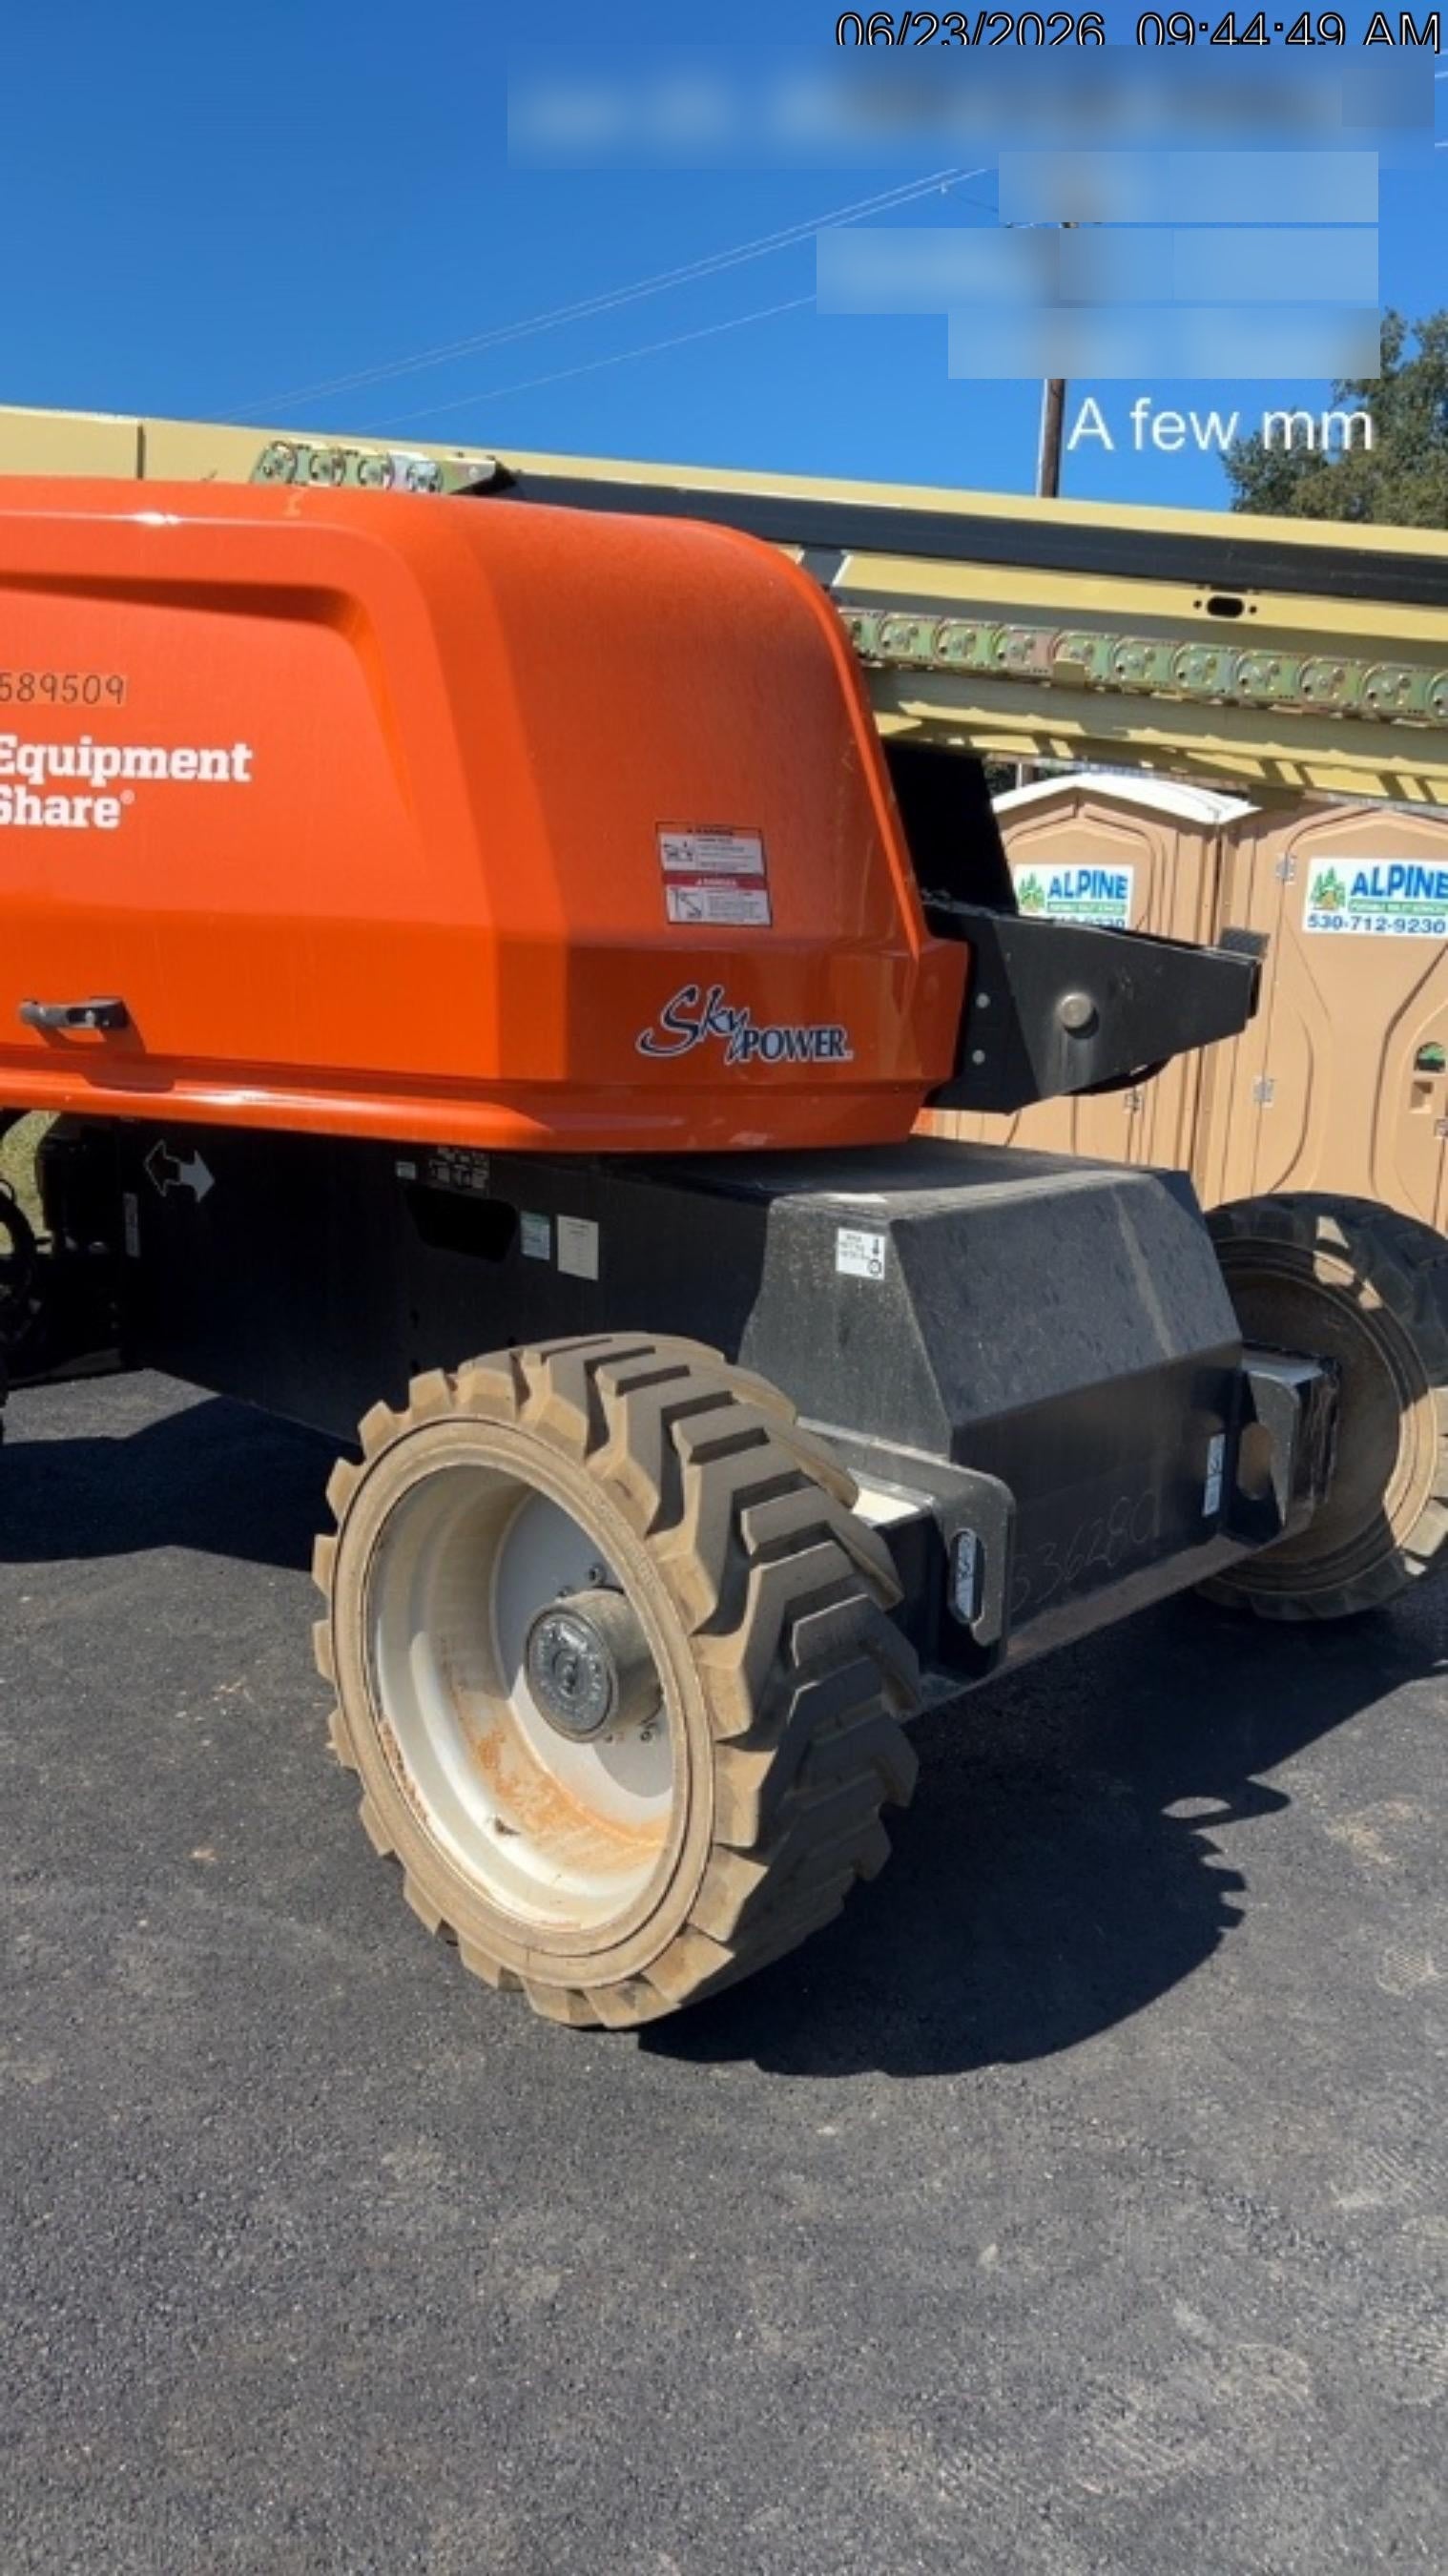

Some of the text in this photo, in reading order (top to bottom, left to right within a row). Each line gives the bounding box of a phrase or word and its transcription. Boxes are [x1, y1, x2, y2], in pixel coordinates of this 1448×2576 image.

[0, 734, 253, 788] Equipment
[1048, 869, 1127, 900] ALPINE
[1351, 863, 1448, 899] ALPINE
[1308, 913, 1445, 934] 530-712-9230
[636, 985, 849, 1066] Sky POWER
